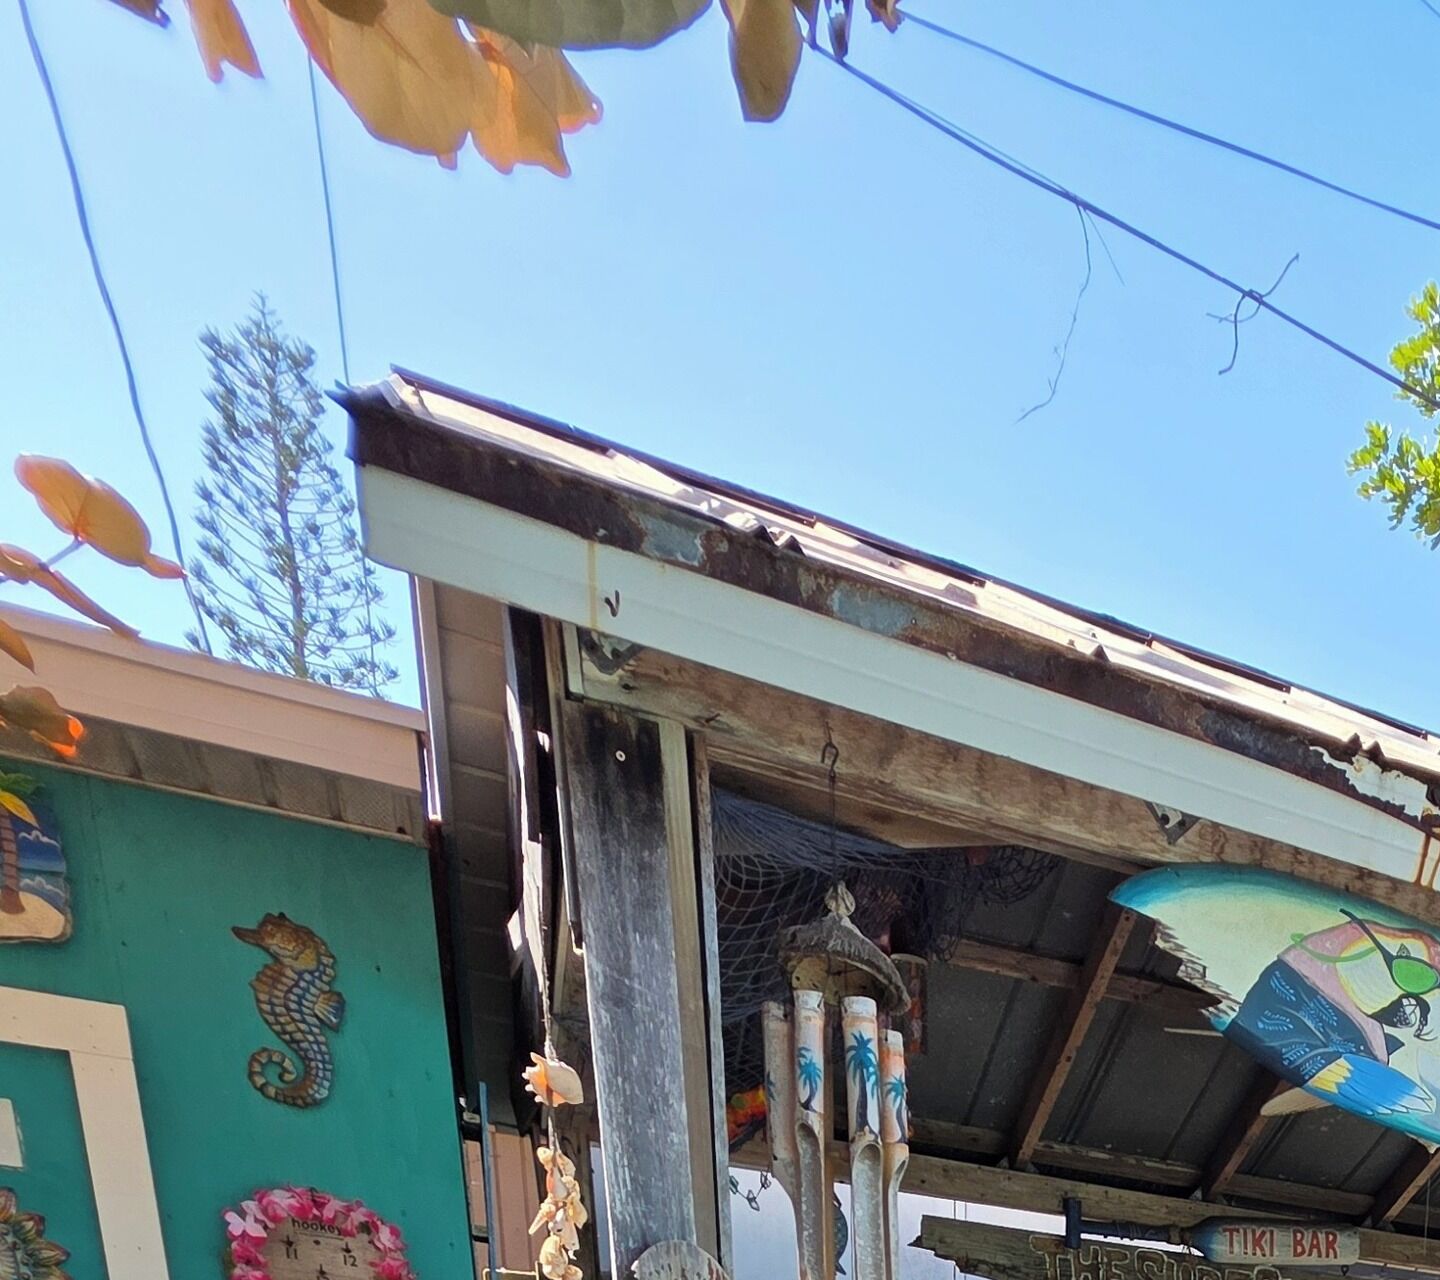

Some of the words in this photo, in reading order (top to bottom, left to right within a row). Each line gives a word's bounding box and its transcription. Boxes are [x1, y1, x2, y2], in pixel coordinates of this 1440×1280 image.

[1222, 1227, 1275, 1257] TIKI
[1292, 1230, 1338, 1259] BAR
[286, 1247, 298, 1260] 11
[343, 1254, 358, 1267] 12
